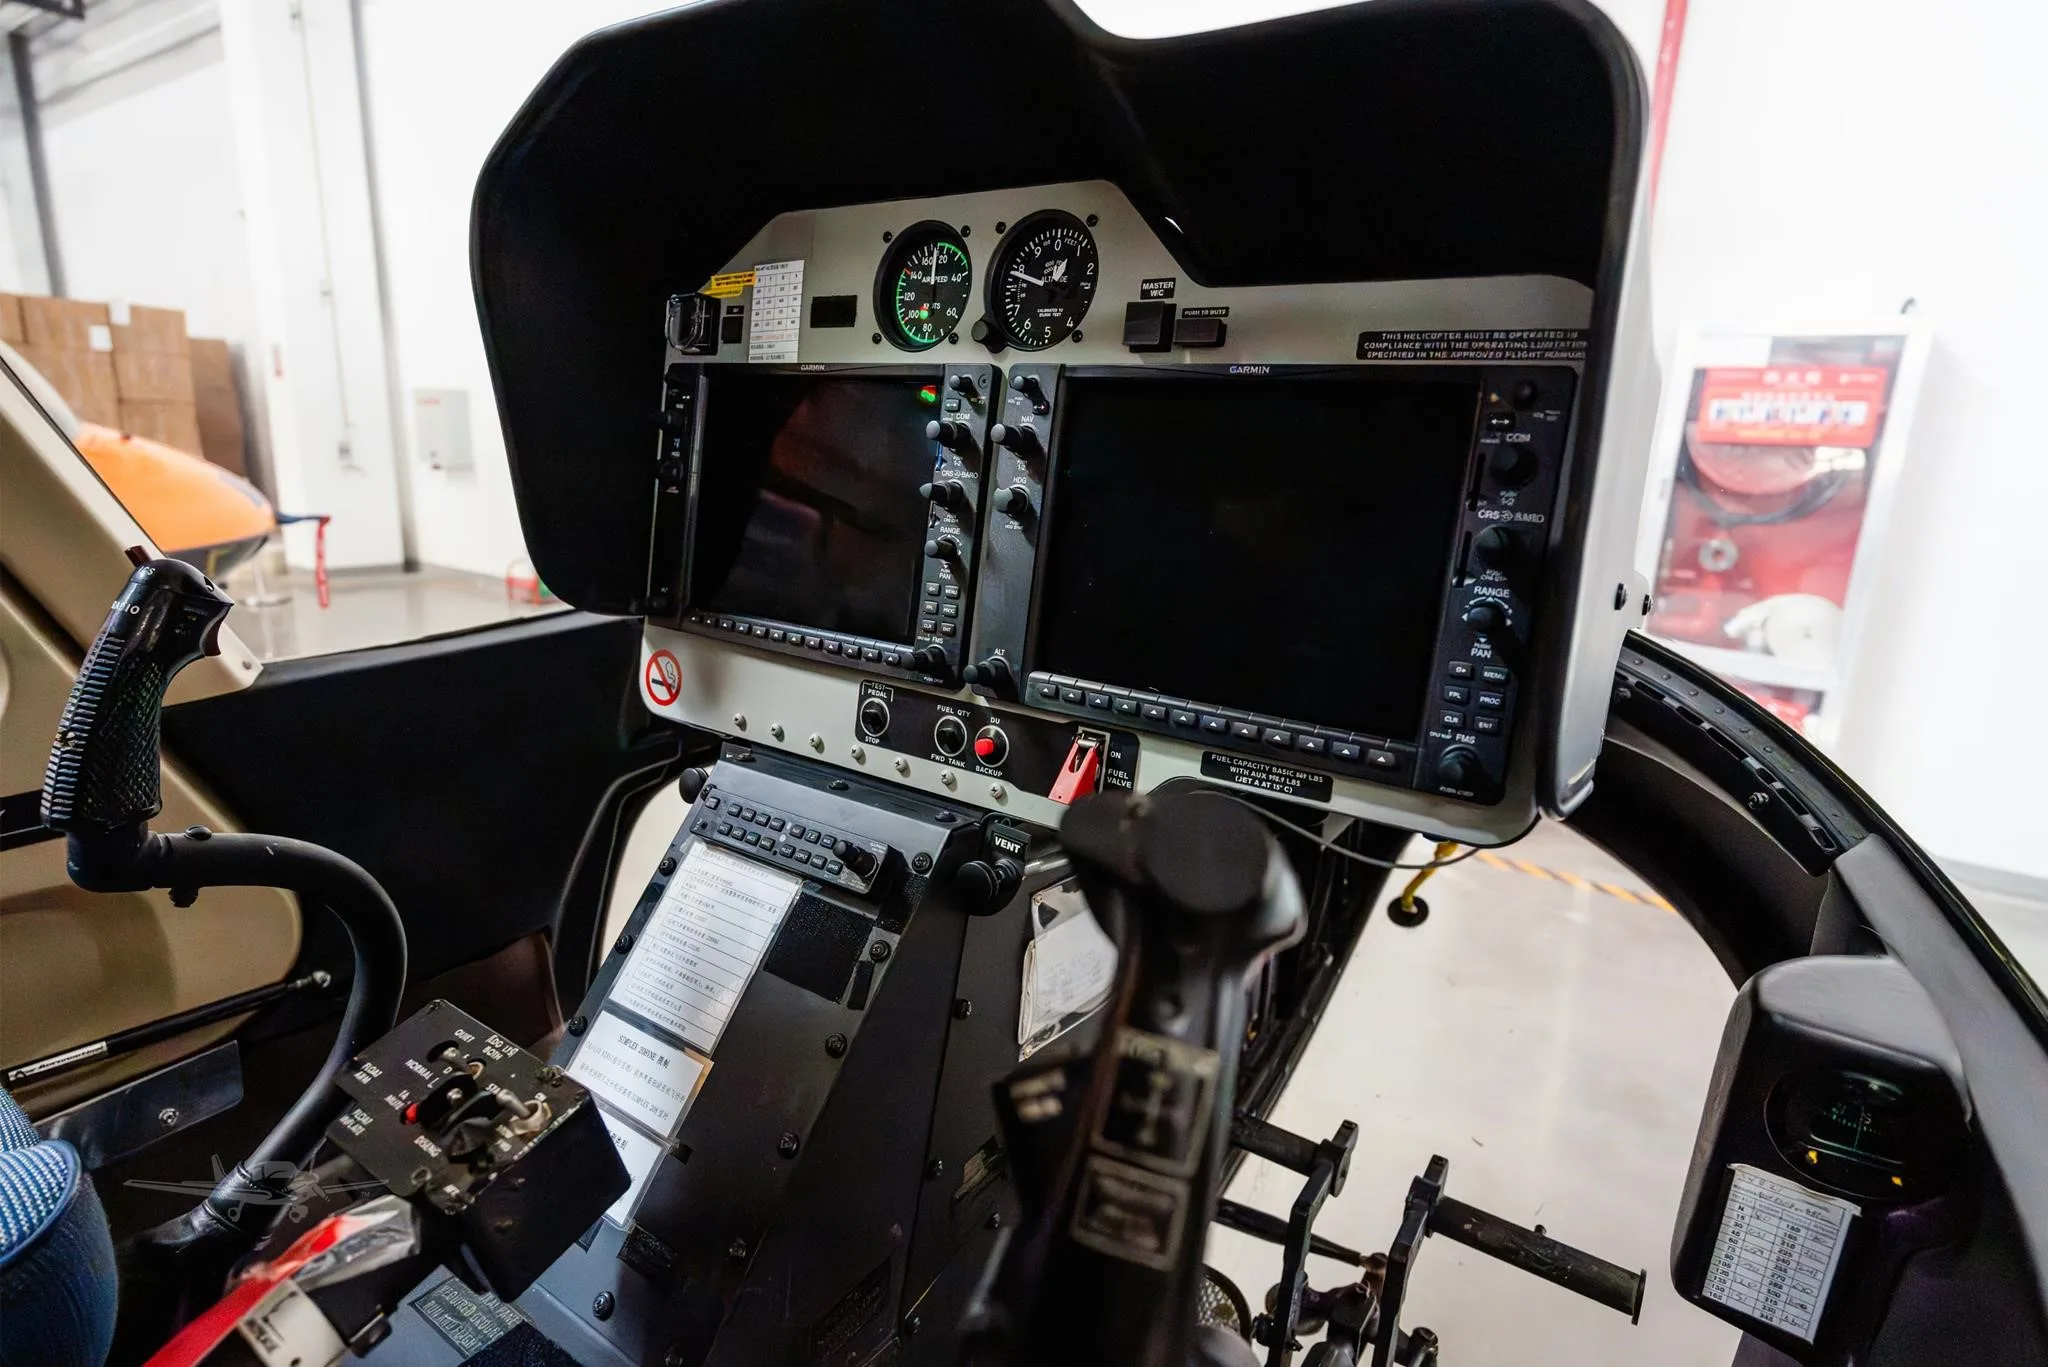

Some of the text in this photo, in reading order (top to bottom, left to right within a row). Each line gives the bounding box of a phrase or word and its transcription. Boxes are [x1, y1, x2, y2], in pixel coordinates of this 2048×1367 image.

[1055, 239, 1061, 252] 0
[1077, 245, 1082, 256] 1
[1034, 246, 1042, 258] 9
[922, 257, 933, 265] 160
[938, 255, 948, 264] 20
[1086, 262, 1095, 275] 2
[910, 271, 922, 280] 140
[951, 273, 962, 282] 40
[1142, 281, 1174, 290] MASTER
[904, 292, 916, 301] 120
[908, 310, 919, 319] 100
[946, 308, 957, 316] 60
[1014, 304, 1020, 316] 7
[1023, 318, 1032, 330] 6
[1066, 316, 1073, 327] 4
[922, 324, 932, 332] 80
[1044, 326, 1051, 338] 5
[1403, 332, 1461, 340] HELICOPTER
[1464, 332, 1491, 340] MUST
[1508, 331, 1564, 339] OPERATED
[1471, 341, 1528, 349] OPERATING
[1367, 351, 1414, 359] SPECIFIED
[1230, 366, 1270, 374] GARMIN
[1021, 415, 1034, 423] NAV
[1507, 433, 1531, 442] COM
[1478, 510, 1500, 520] CRS
[940, 526, 960, 535] RANGE
[1474, 585, 1510, 598] RANGE
[994, 648, 1006, 656] ALT
[1471, 648, 1492, 658] PAN
[872, 682, 885, 690] TEST
[868, 688, 888, 698] PEDAL
[1480, 696, 1500, 705] PROC
[937, 705, 971, 718] FUEL QTY
[865, 736, 880, 744] STOP
[1456, 734, 1476, 744] FMS
[1110, 751, 1121, 759] ON
[931, 754, 966, 768] FWD TANK
[976, 765, 1003, 777] BACKUP
[1212, 754, 1232, 764] FUEL
[1233, 759, 1270, 772] CAPACITY
[1271, 767, 1294, 777] BASIC
[1309, 774, 1323, 783] LBS
[1108, 769, 1129, 779] FUEL
[1230, 766, 1249, 776] WITH
[1251, 770, 1266, 779] AUX
[1286, 779, 1301, 787] LBS
[1107, 777, 1132, 788] VALVE
[1235, 776, 1252, 784] (JET
[1284, 786, 1293, 794] C)
[995, 836, 1021, 853] VENT
[454, 1028, 476, 1043] QUIET
[481, 1045, 504, 1061] BOTH
[361, 1062, 383, 1078] FLOAT
[405, 1059, 434, 1080] NORMAL
[353, 1071, 372, 1084] ARM
[352, 1108, 374, 1125] FLOAT
